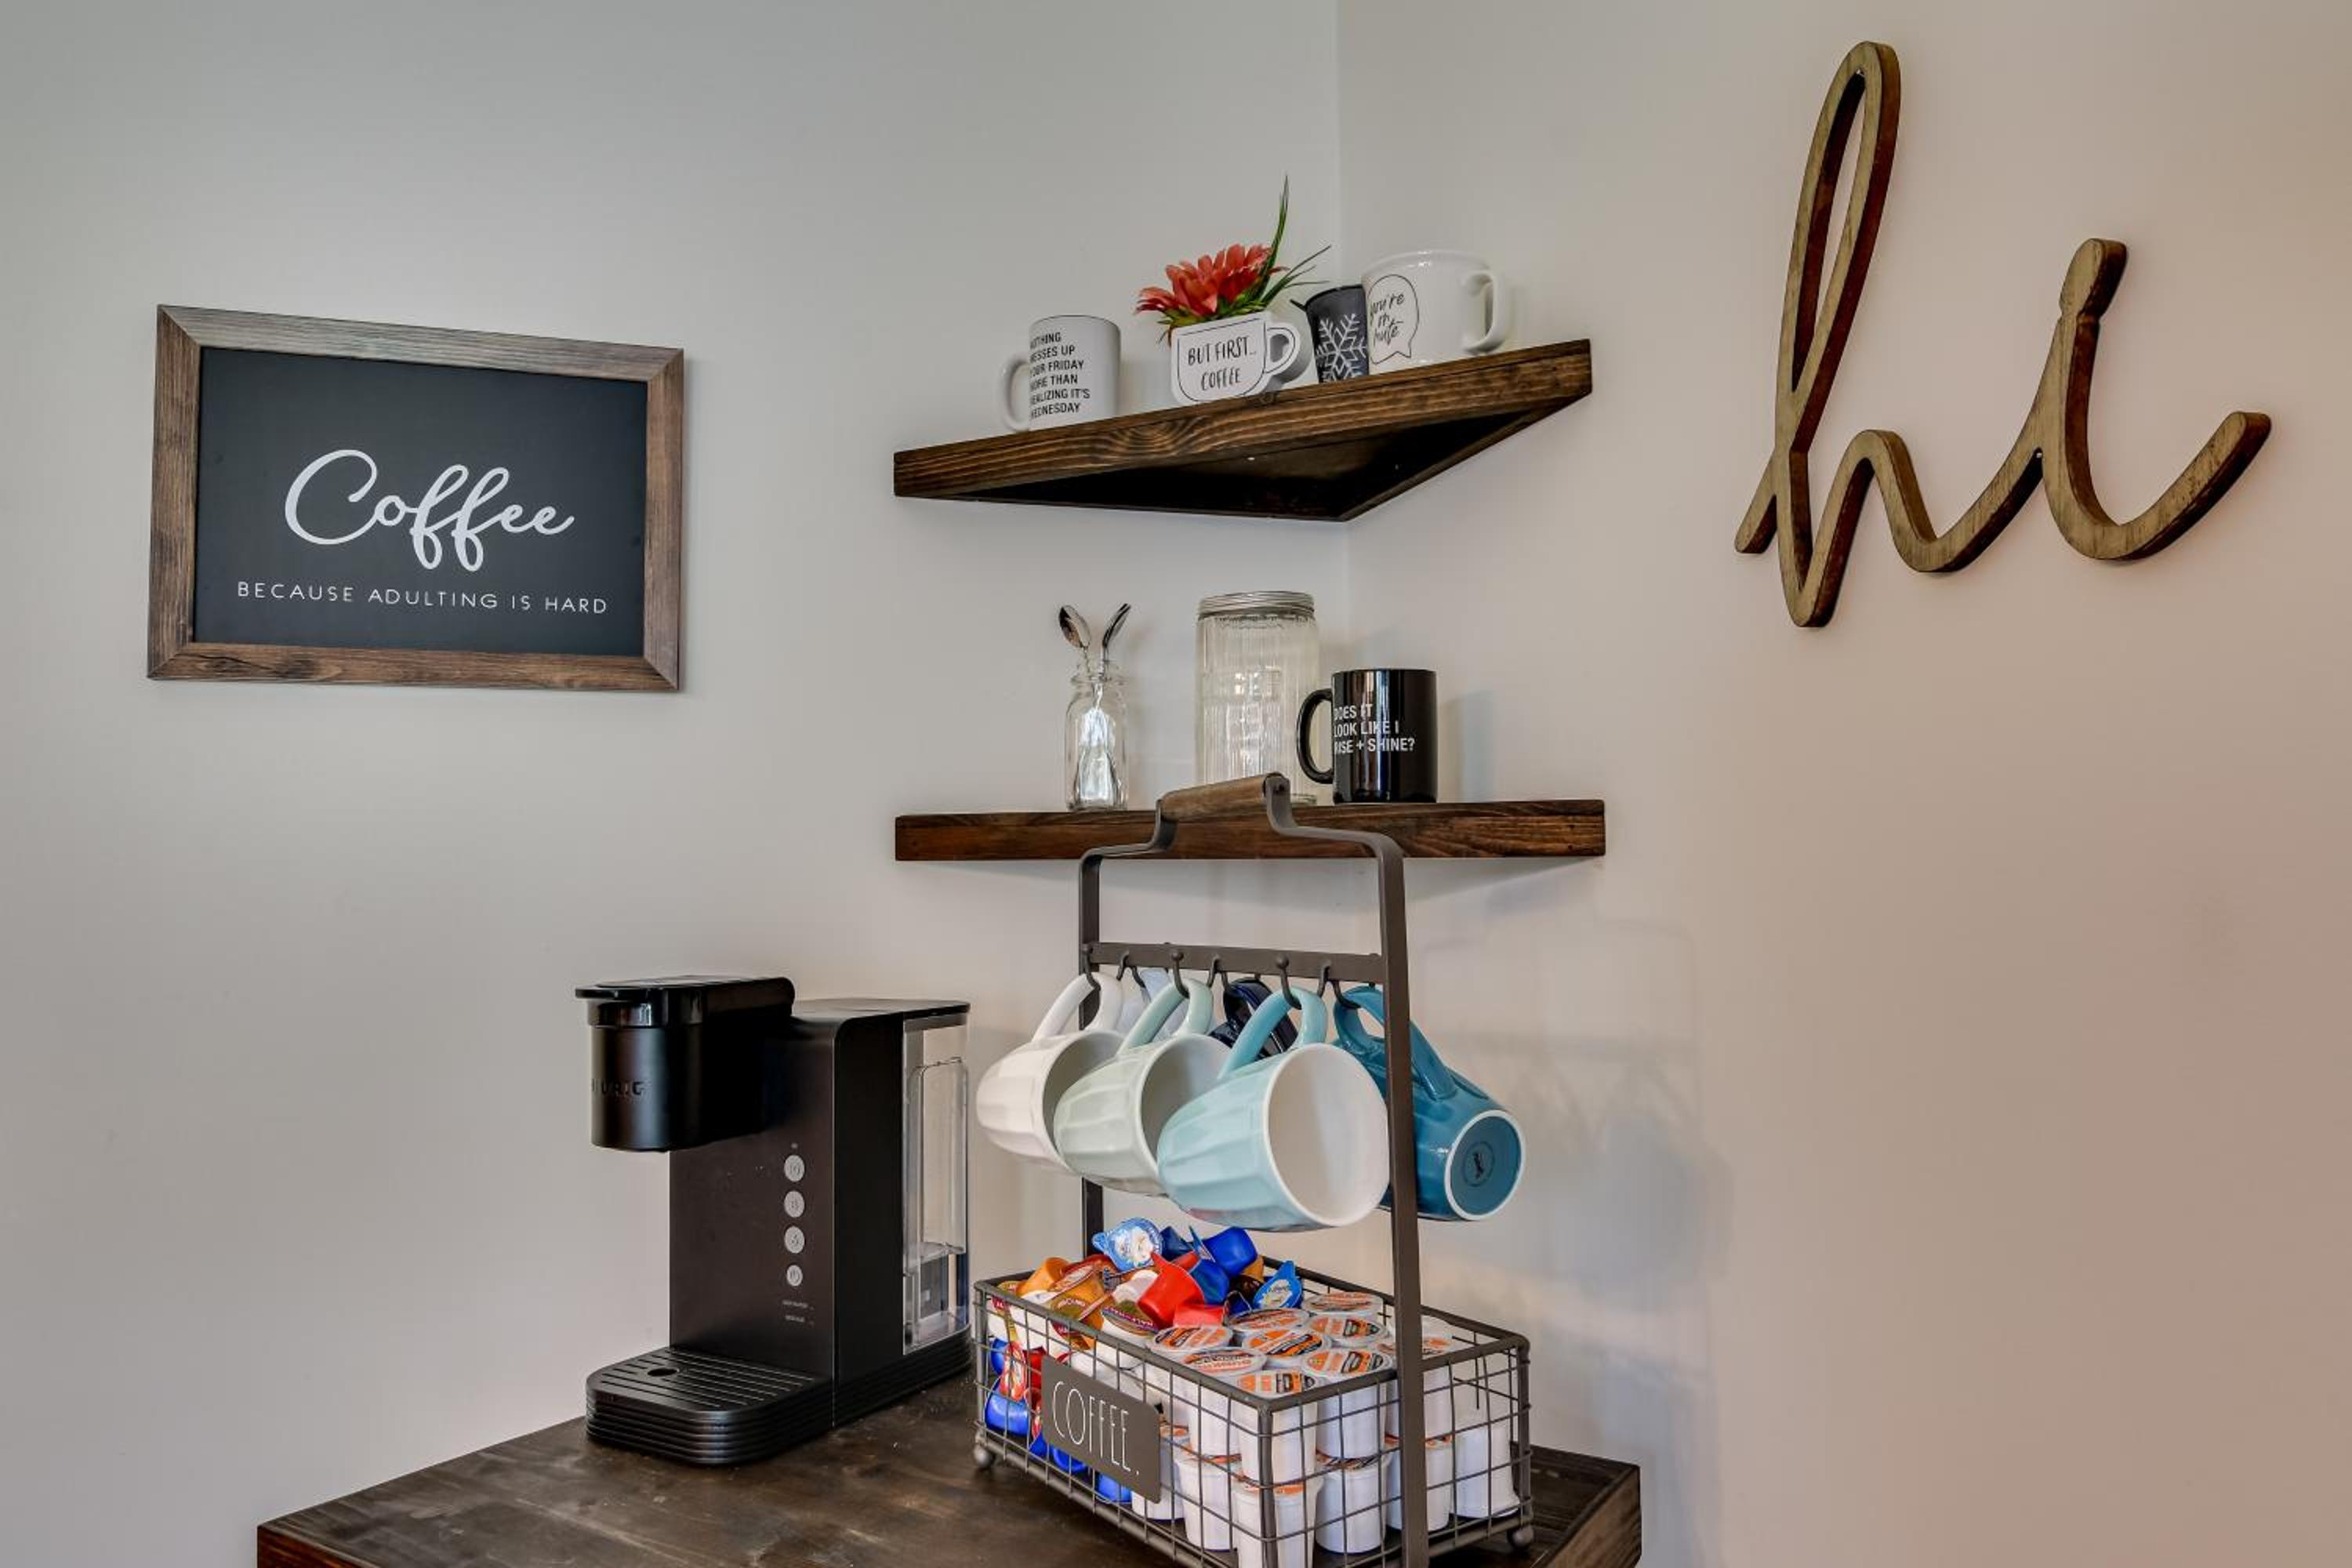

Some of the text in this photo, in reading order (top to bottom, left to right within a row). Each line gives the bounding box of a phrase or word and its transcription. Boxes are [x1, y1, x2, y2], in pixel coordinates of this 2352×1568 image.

[1733, 40, 2271, 628] hi
[1030, 344, 1076, 363] ESSES UP
[1188, 343, 1212, 366] BUT
[1048, 359, 1084, 372] FRIDAY
[1051, 374, 1078, 386] THAN
[1201, 366, 1241, 391] COFFEE
[1070, 388, 1091, 399] IT'S
[285, 448, 575, 571] Coffee
[238, 581, 607, 614] BECAUSE ADULTING IS HARD
[1361, 703, 1374, 718] IT
[1334, 720, 1399, 738] LOOK LIKE I
[1367, 737, 1416, 752] SHINE?
[1053, 1381, 1139, 1475] COFFEE.
